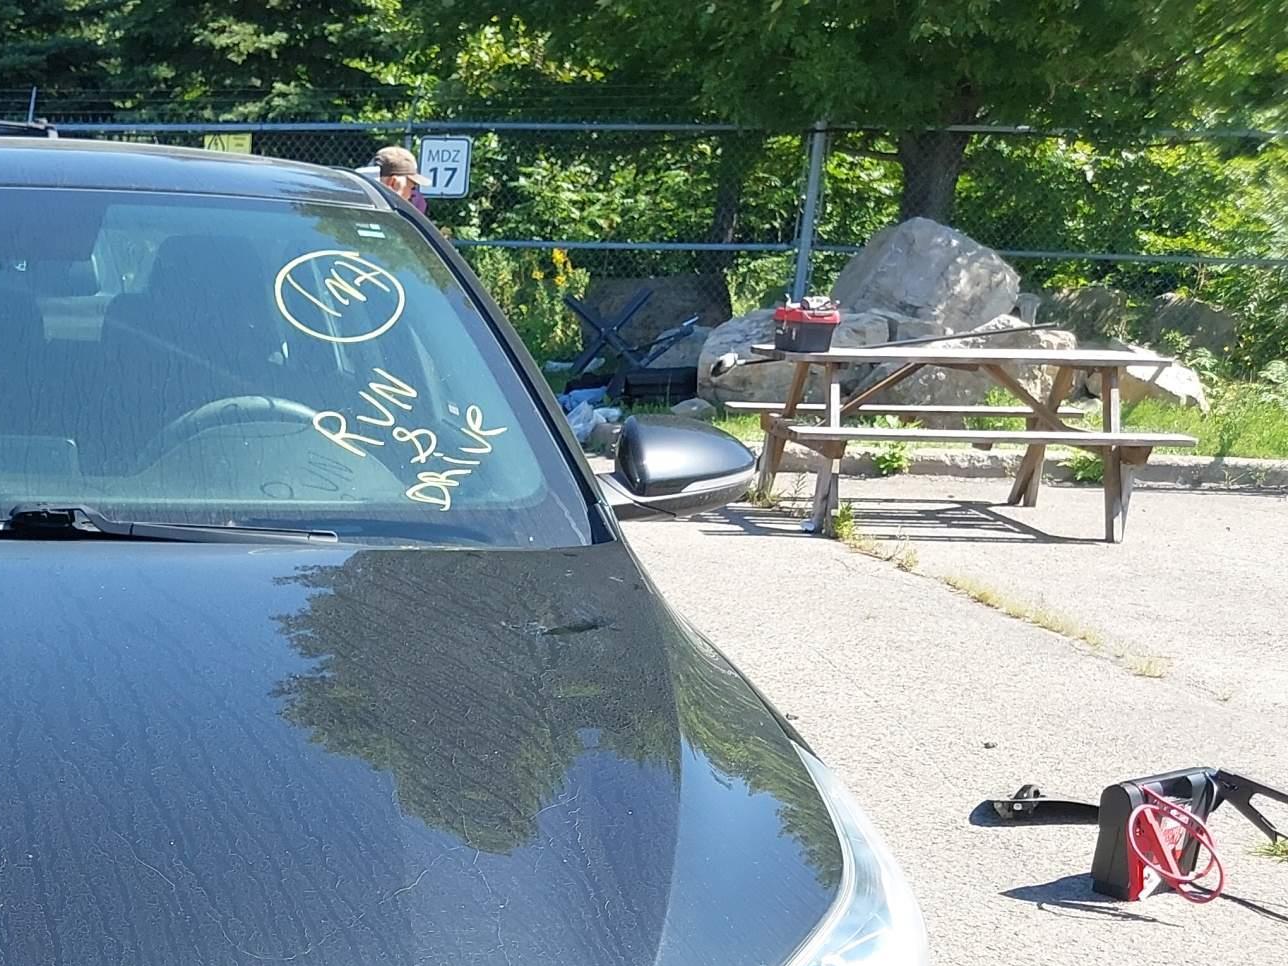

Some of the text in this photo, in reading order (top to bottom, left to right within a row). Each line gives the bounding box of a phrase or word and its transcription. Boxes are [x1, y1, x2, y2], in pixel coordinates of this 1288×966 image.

[427, 149, 461, 164] MDZ
[429, 167, 458, 188] 17
[312, 367, 418, 458] RUN
